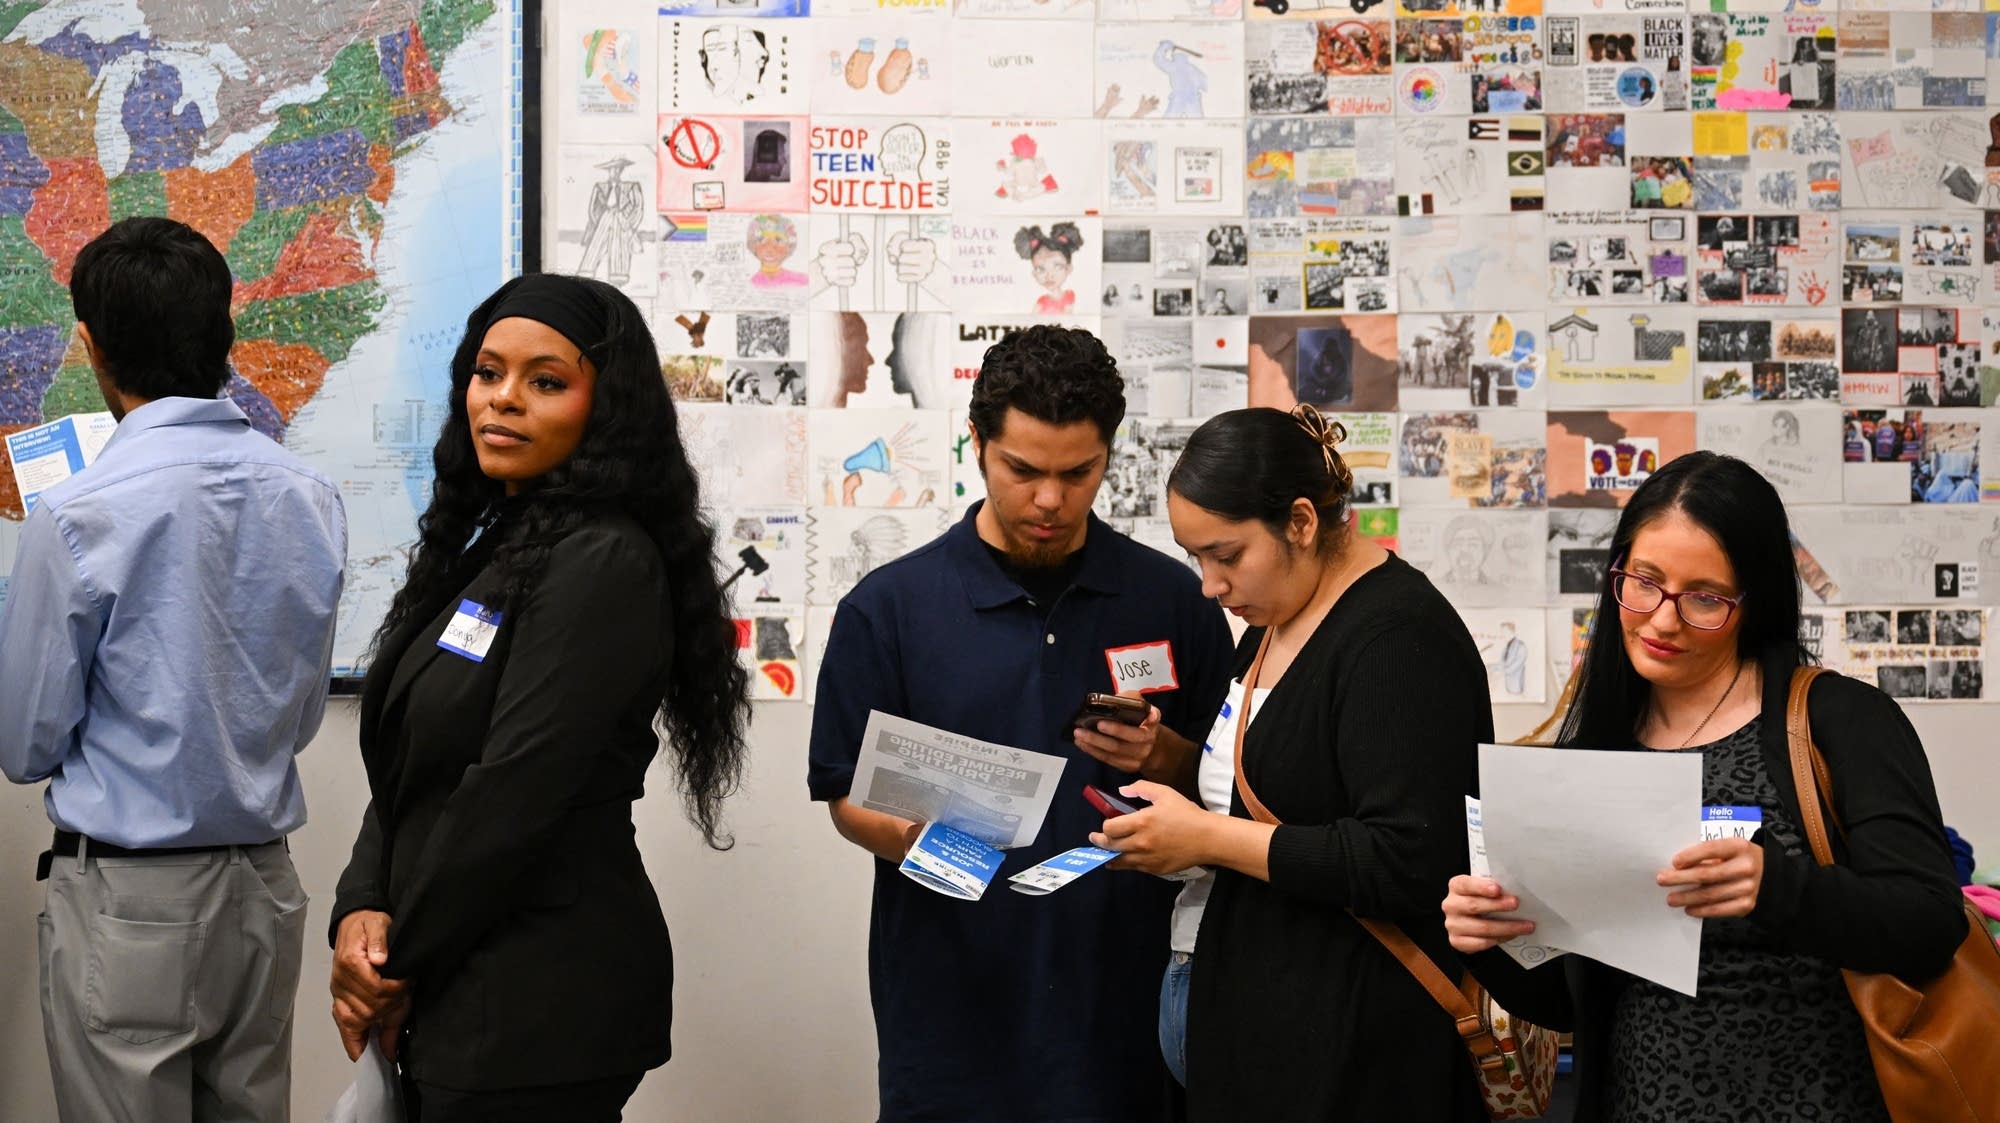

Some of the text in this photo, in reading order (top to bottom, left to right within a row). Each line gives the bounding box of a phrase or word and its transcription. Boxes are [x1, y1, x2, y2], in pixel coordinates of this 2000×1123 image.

[1644, 19, 1683, 30] BLACK
[1648, 33, 1680, 45] LIVES
[1644, 48, 1683, 59] MATTER
[988, 55, 1034, 68] WOMEN
[810, 127, 869, 149] STOP
[813, 152, 875, 172] TEEN
[811, 179, 934, 210] SUICIDE
[44, 216, 102, 225] ILLINOIS
[952, 225, 999, 241] BLACK
[959, 246, 996, 257] HAIR
[973, 258, 986, 268] IS
[952, 273, 1015, 285] BEAUTIFUL
[1591, 478, 1616, 488] VOTE
[1116, 659, 1152, 681] Jose
[930, 837, 991, 870] RESOURCE
[951, 855, 974, 868] JOB
